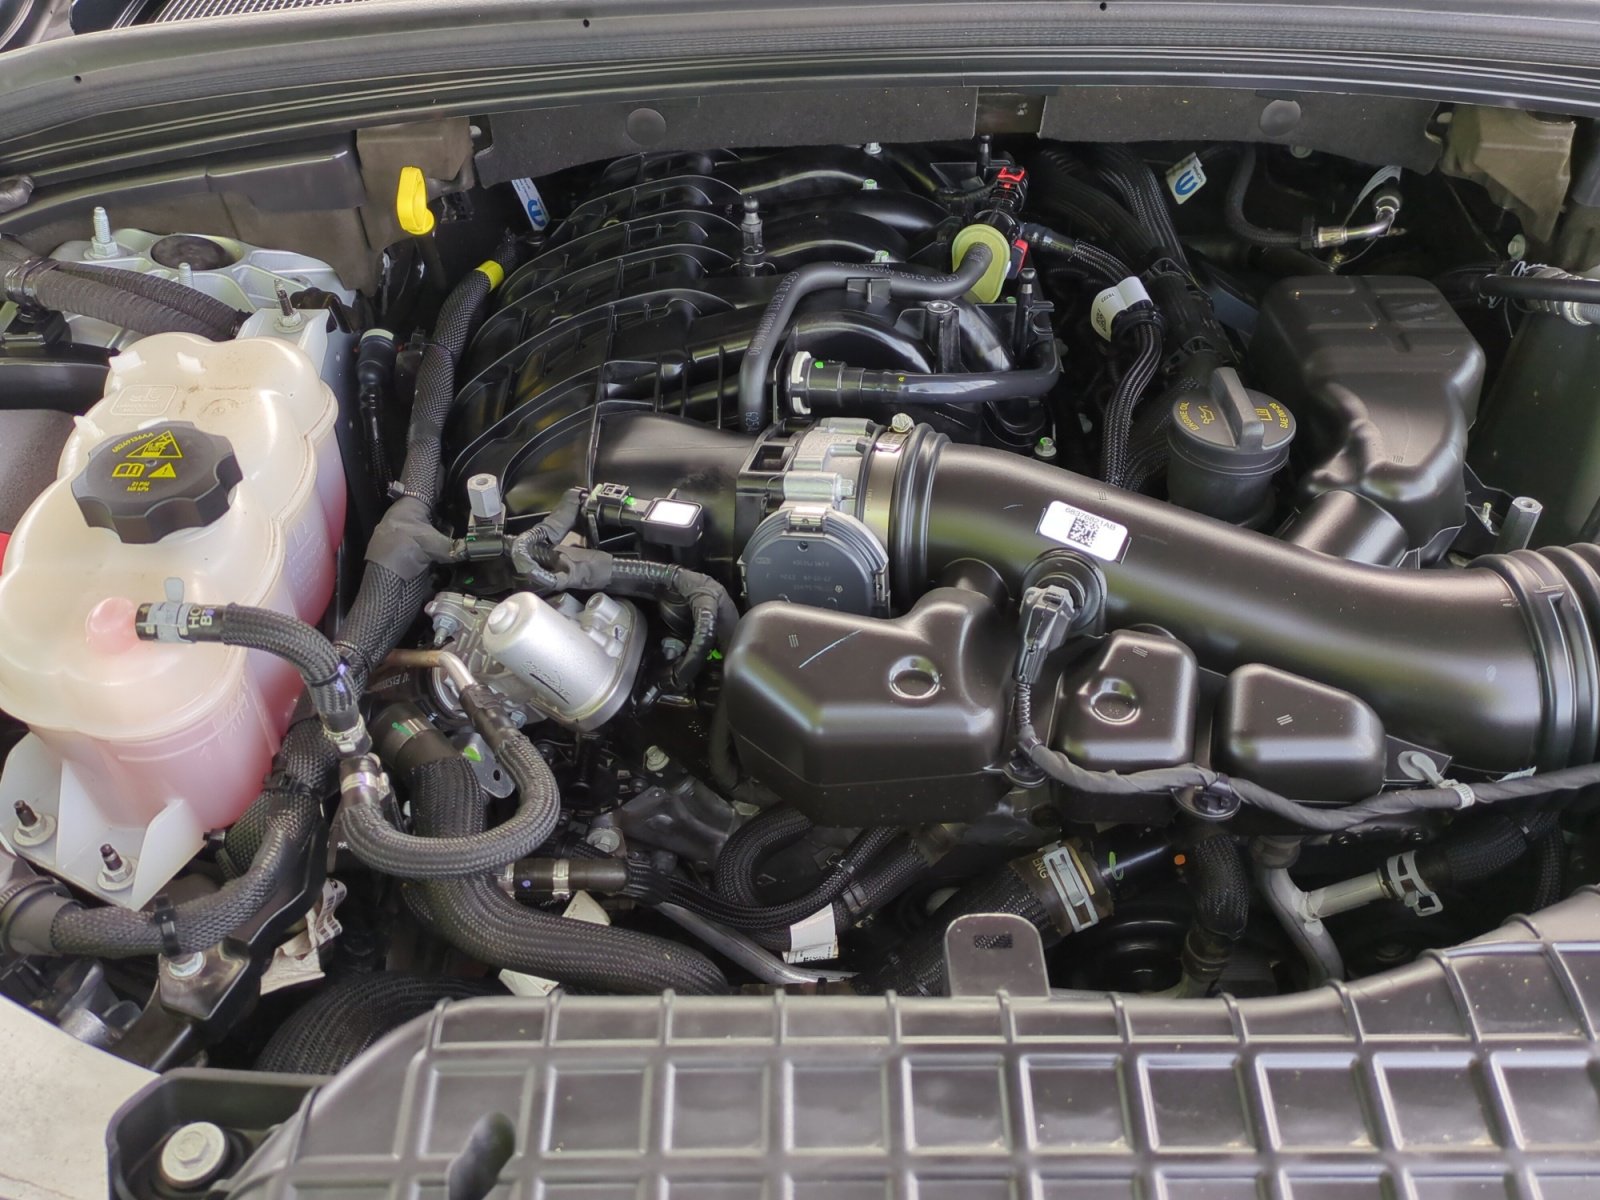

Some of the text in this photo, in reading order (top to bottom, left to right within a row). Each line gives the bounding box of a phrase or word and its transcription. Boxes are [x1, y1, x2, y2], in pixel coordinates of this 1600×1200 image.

[1180, 410, 1200, 431] ENGINE
[1279, 418, 1289, 429] SAE
[1065, 507, 1117, 531] 68376821AB
